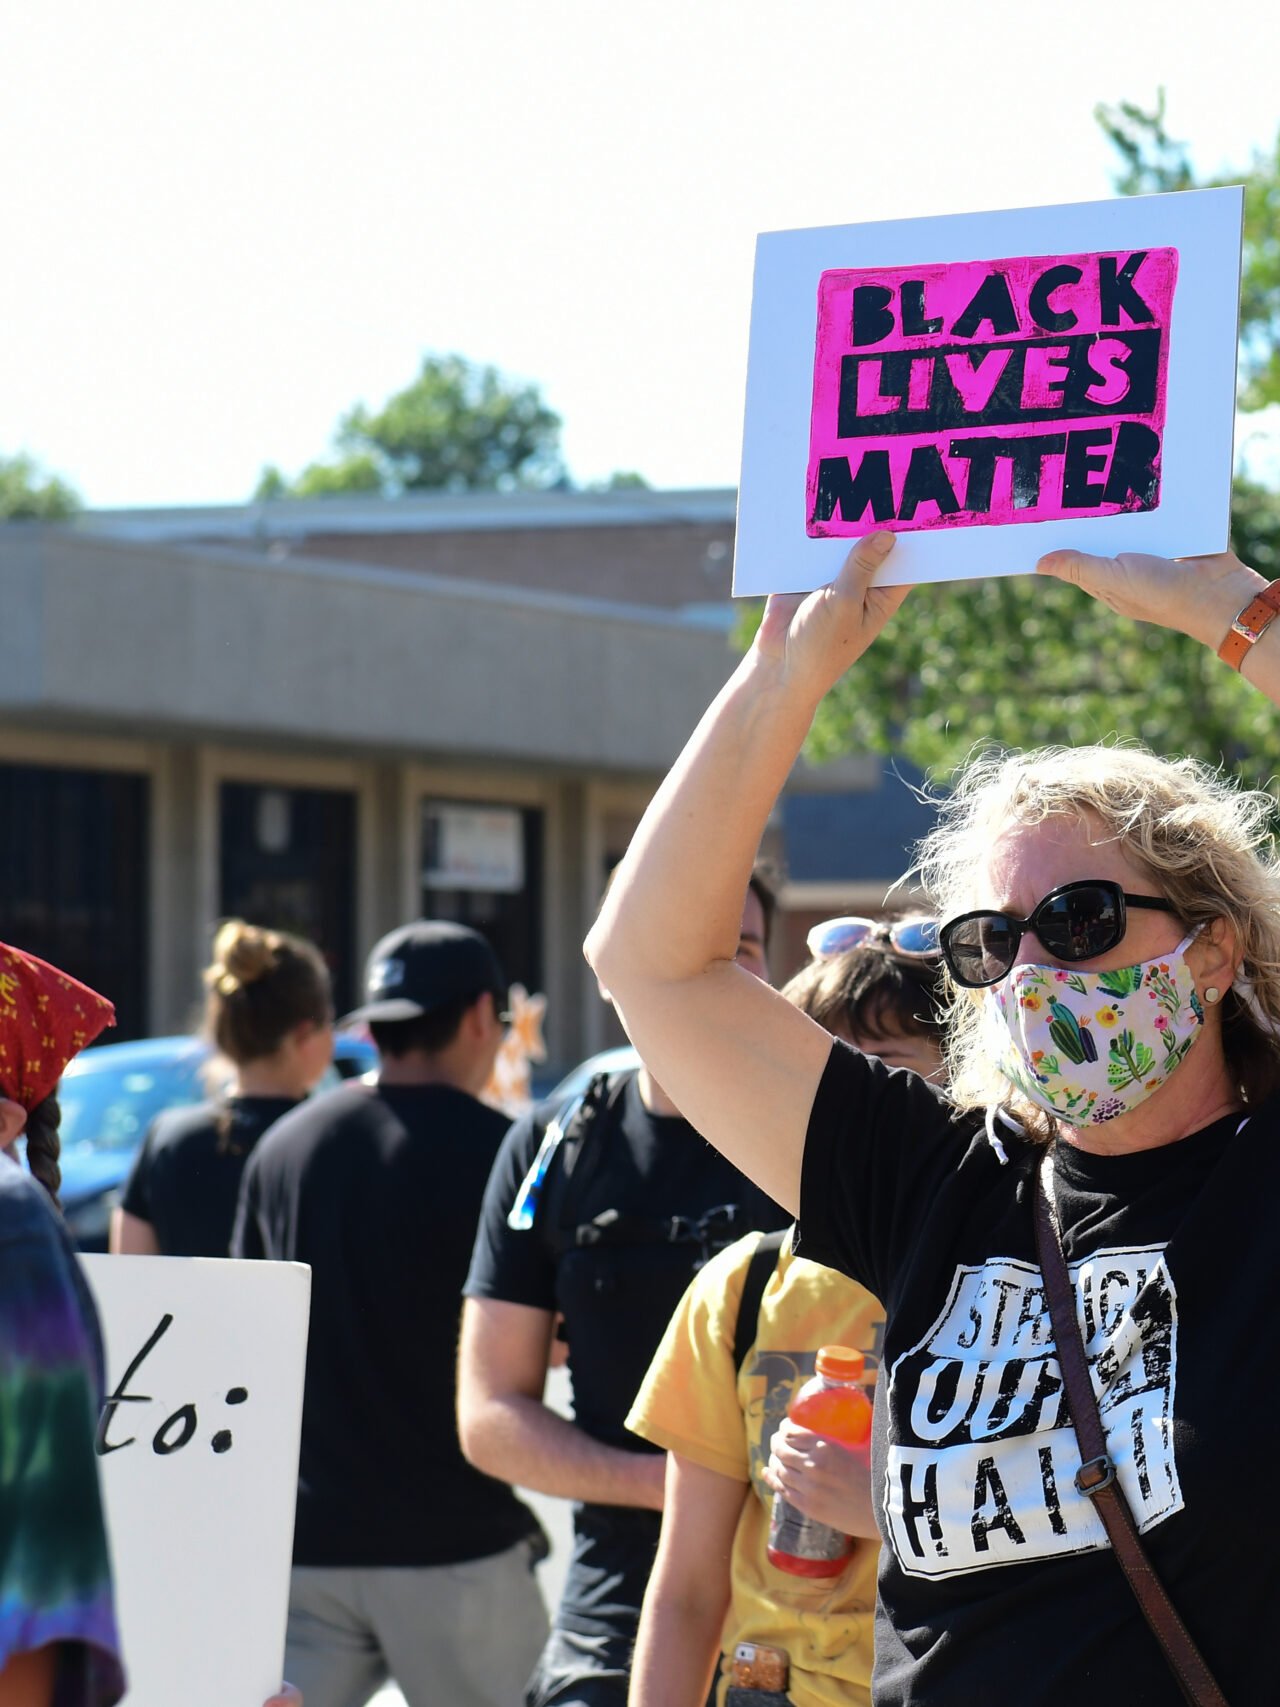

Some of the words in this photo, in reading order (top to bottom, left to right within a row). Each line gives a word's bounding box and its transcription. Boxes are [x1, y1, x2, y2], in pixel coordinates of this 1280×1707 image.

[852, 251, 1155, 347] BLACK
[856, 338, 1133, 418] LIVES
[814, 422, 1161, 522] MATTER
[97, 1313, 249, 1456] to:
[900, 1407, 1152, 1558] HAII
